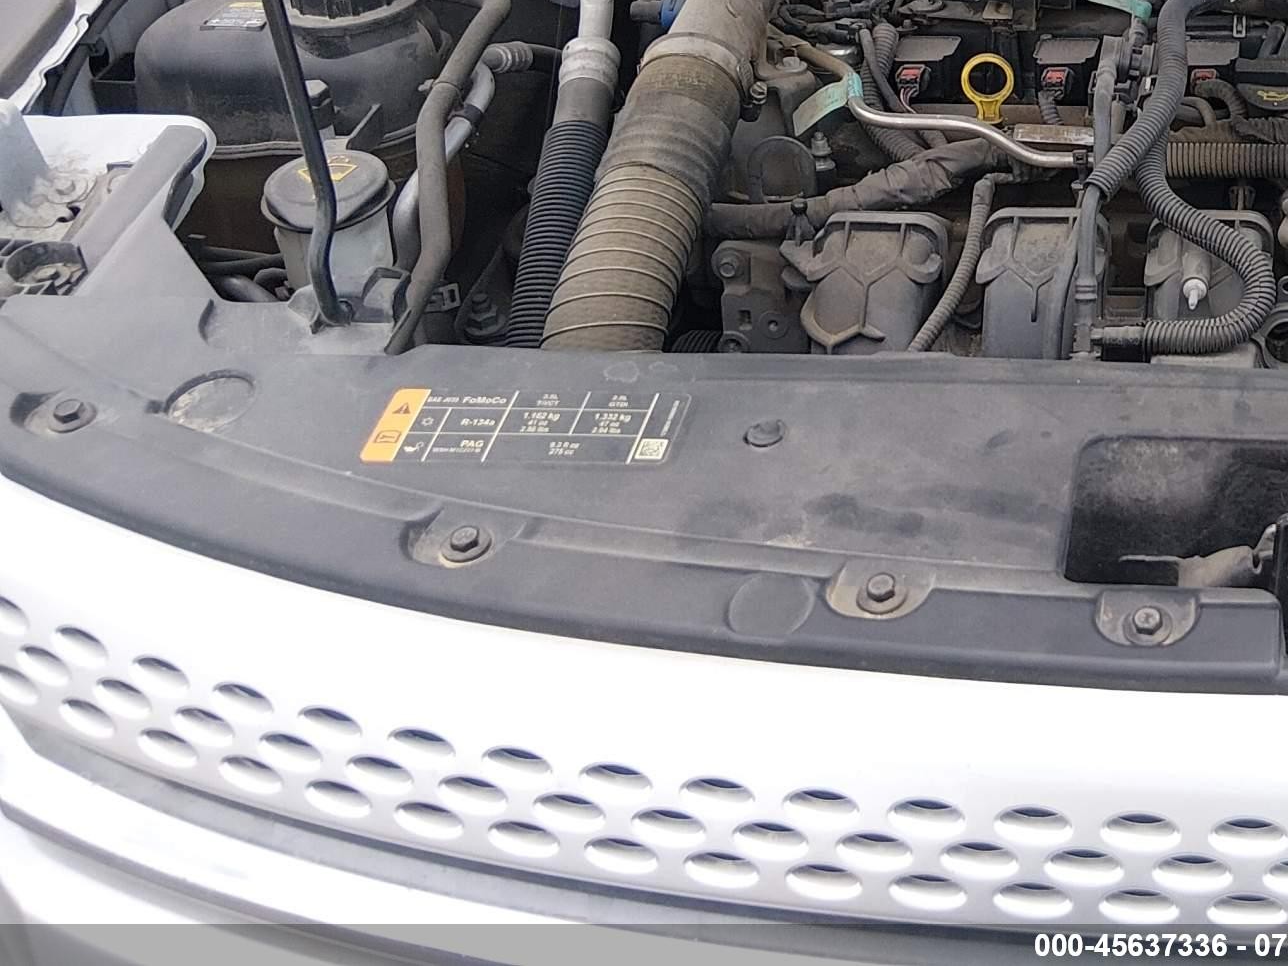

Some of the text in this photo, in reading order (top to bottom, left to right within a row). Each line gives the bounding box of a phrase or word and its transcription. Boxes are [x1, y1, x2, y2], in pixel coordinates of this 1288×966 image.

[462, 396, 507, 404] FoMoCo
[548, 412, 561, 422] kg
[619, 413, 632, 423] kg
[460, 418, 495, 426] R-134a
